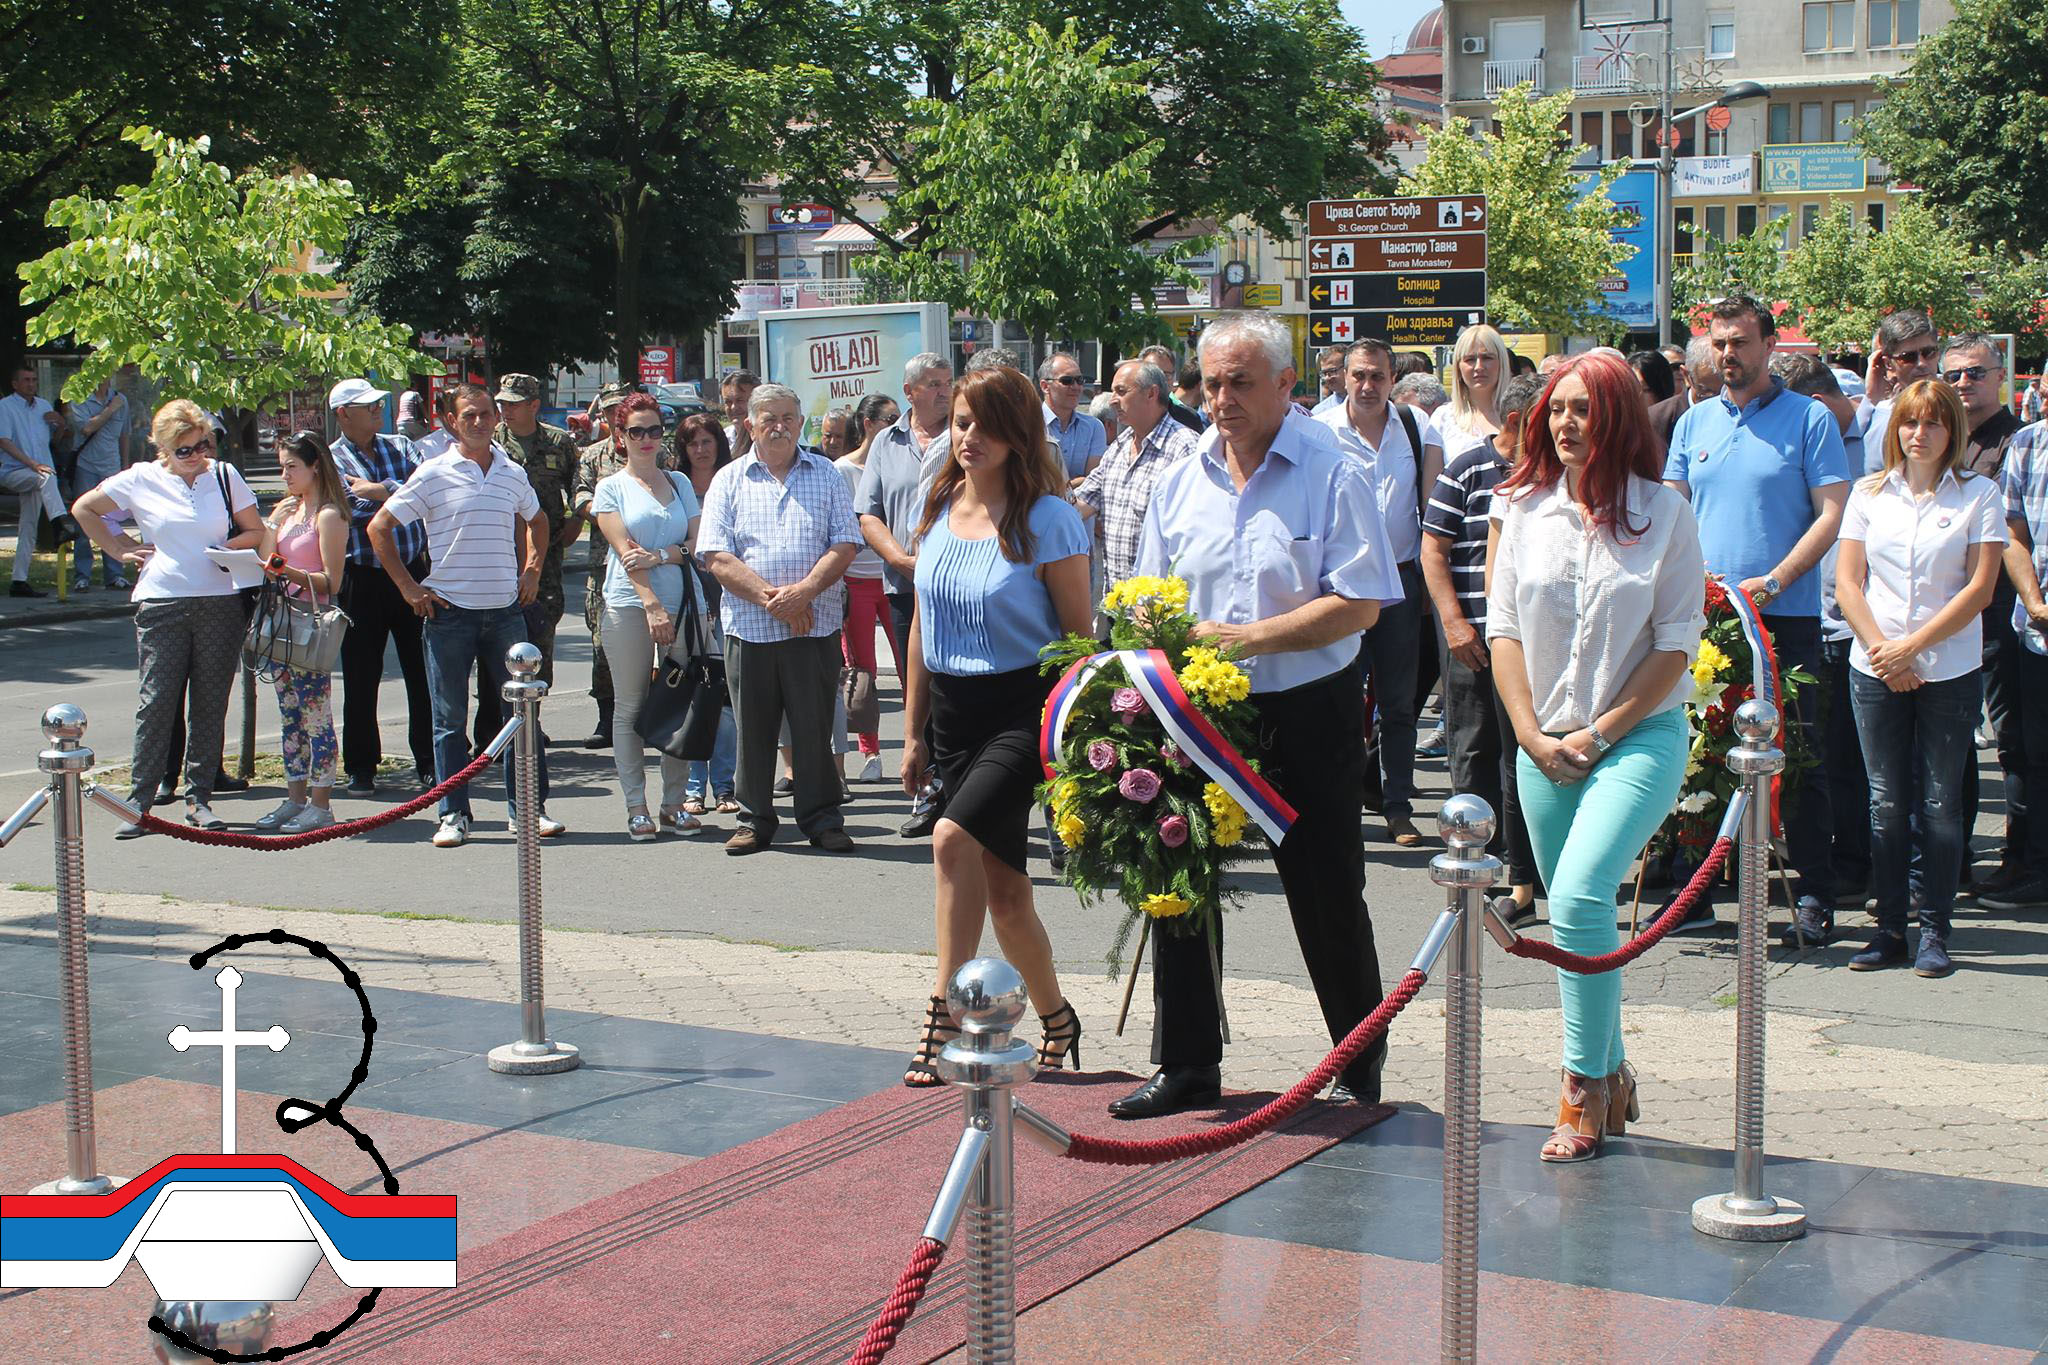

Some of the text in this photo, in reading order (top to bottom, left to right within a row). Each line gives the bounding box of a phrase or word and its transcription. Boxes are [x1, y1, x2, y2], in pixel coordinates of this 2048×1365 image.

[1703, 159, 1730, 169] BUDITE
[1684, 172, 1715, 186] AKTIVNI
[1326, 203, 1421, 221] Црква Светог Ђорђа
[1338, 223, 1408, 233] St. George Church
[1381, 239, 1457, 256] Манастир Тавна
[1311, 262, 1329, 270] 29 km
[1387, 259, 1452, 269] Tavna Monastery
[1397, 277, 1440, 292] Болница
[1336, 285, 1348, 301] H
[1403, 296, 1435, 305] Hospital
[1387, 315, 1453, 330] Дом здравља
[964, 326, 972, 339] P
[1392, 333, 1445, 343] Health Center
[809, 335, 880, 373] OHLADI
[830, 378, 865, 399] MALO!
